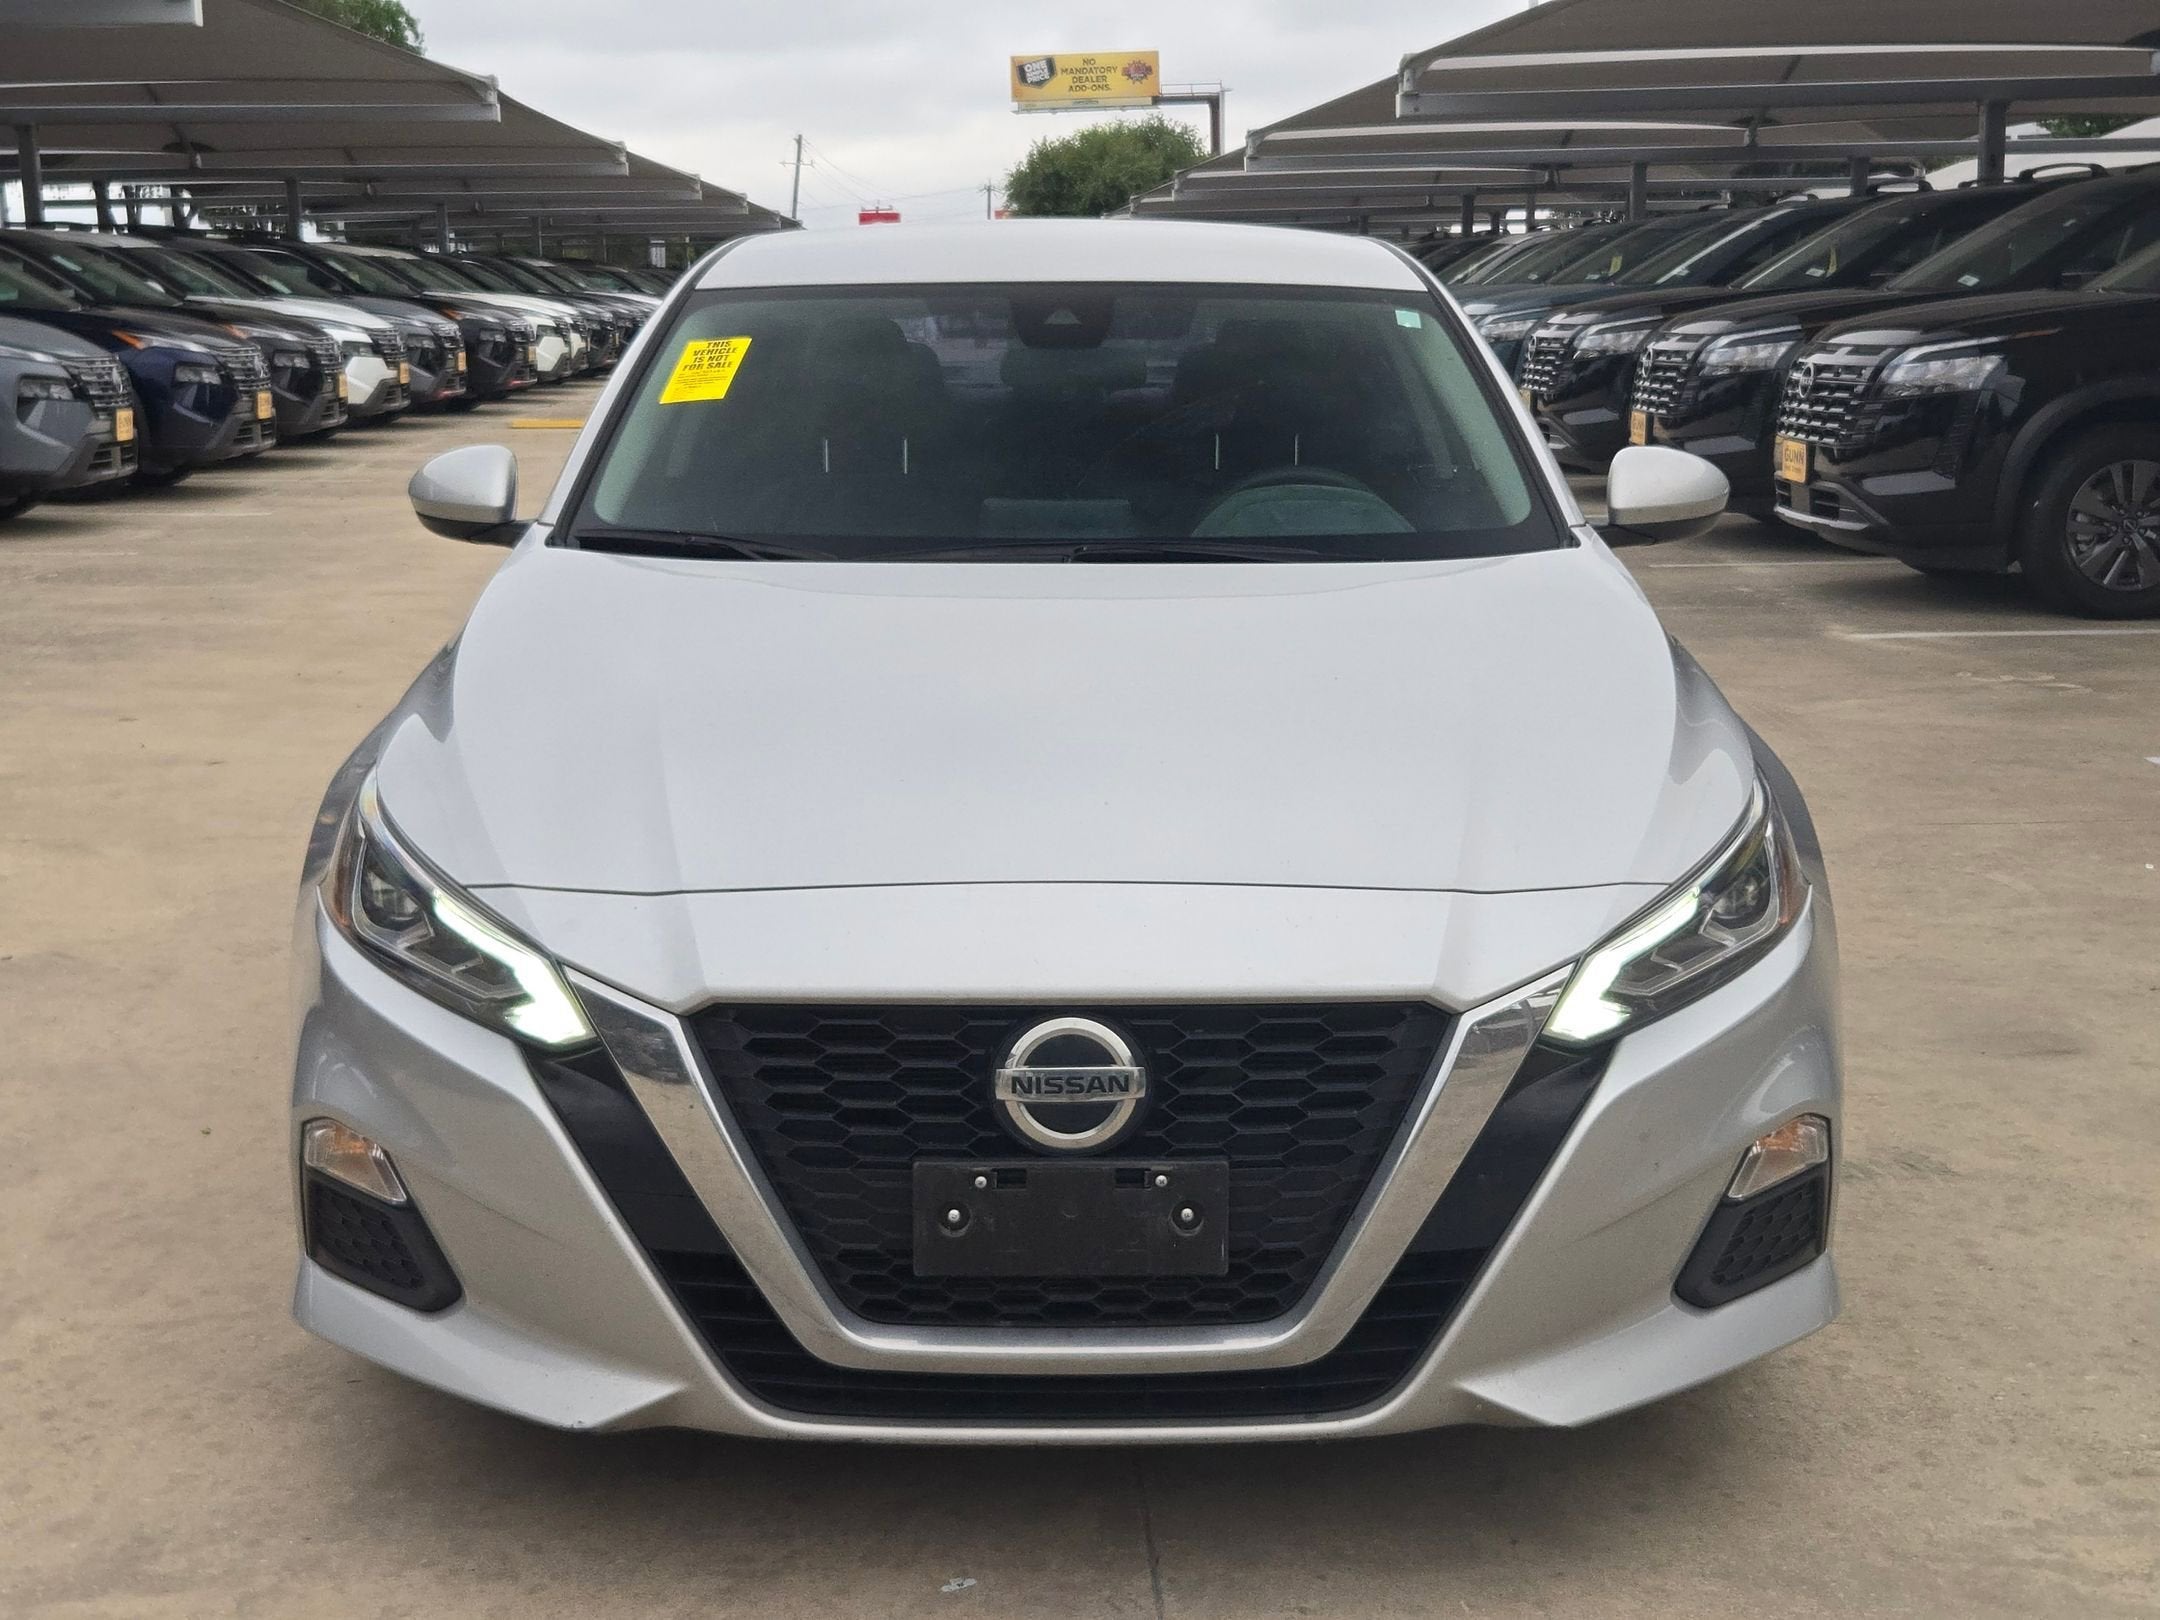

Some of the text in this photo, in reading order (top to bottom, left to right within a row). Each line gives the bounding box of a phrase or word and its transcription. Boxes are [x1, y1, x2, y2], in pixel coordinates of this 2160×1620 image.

[1024, 60, 1048, 72] ONE
[1082, 58, 1097, 66] NO
[1060, 66, 1118, 75] MANDATORY
[1027, 74, 1050, 83] PRICE
[1072, 75, 1107, 84] DEALER
[1068, 84, 1112, 92] ADD-ONS.
[706, 340, 732, 349] THIS
[693, 347, 738, 356] VEHICLE
[693, 354, 729, 364] IS NOT
[682, 361, 733, 371] FOR SALE
[1784, 447, 1805, 464] GUNN
[1011, 1075, 1129, 1095] NISSAN
